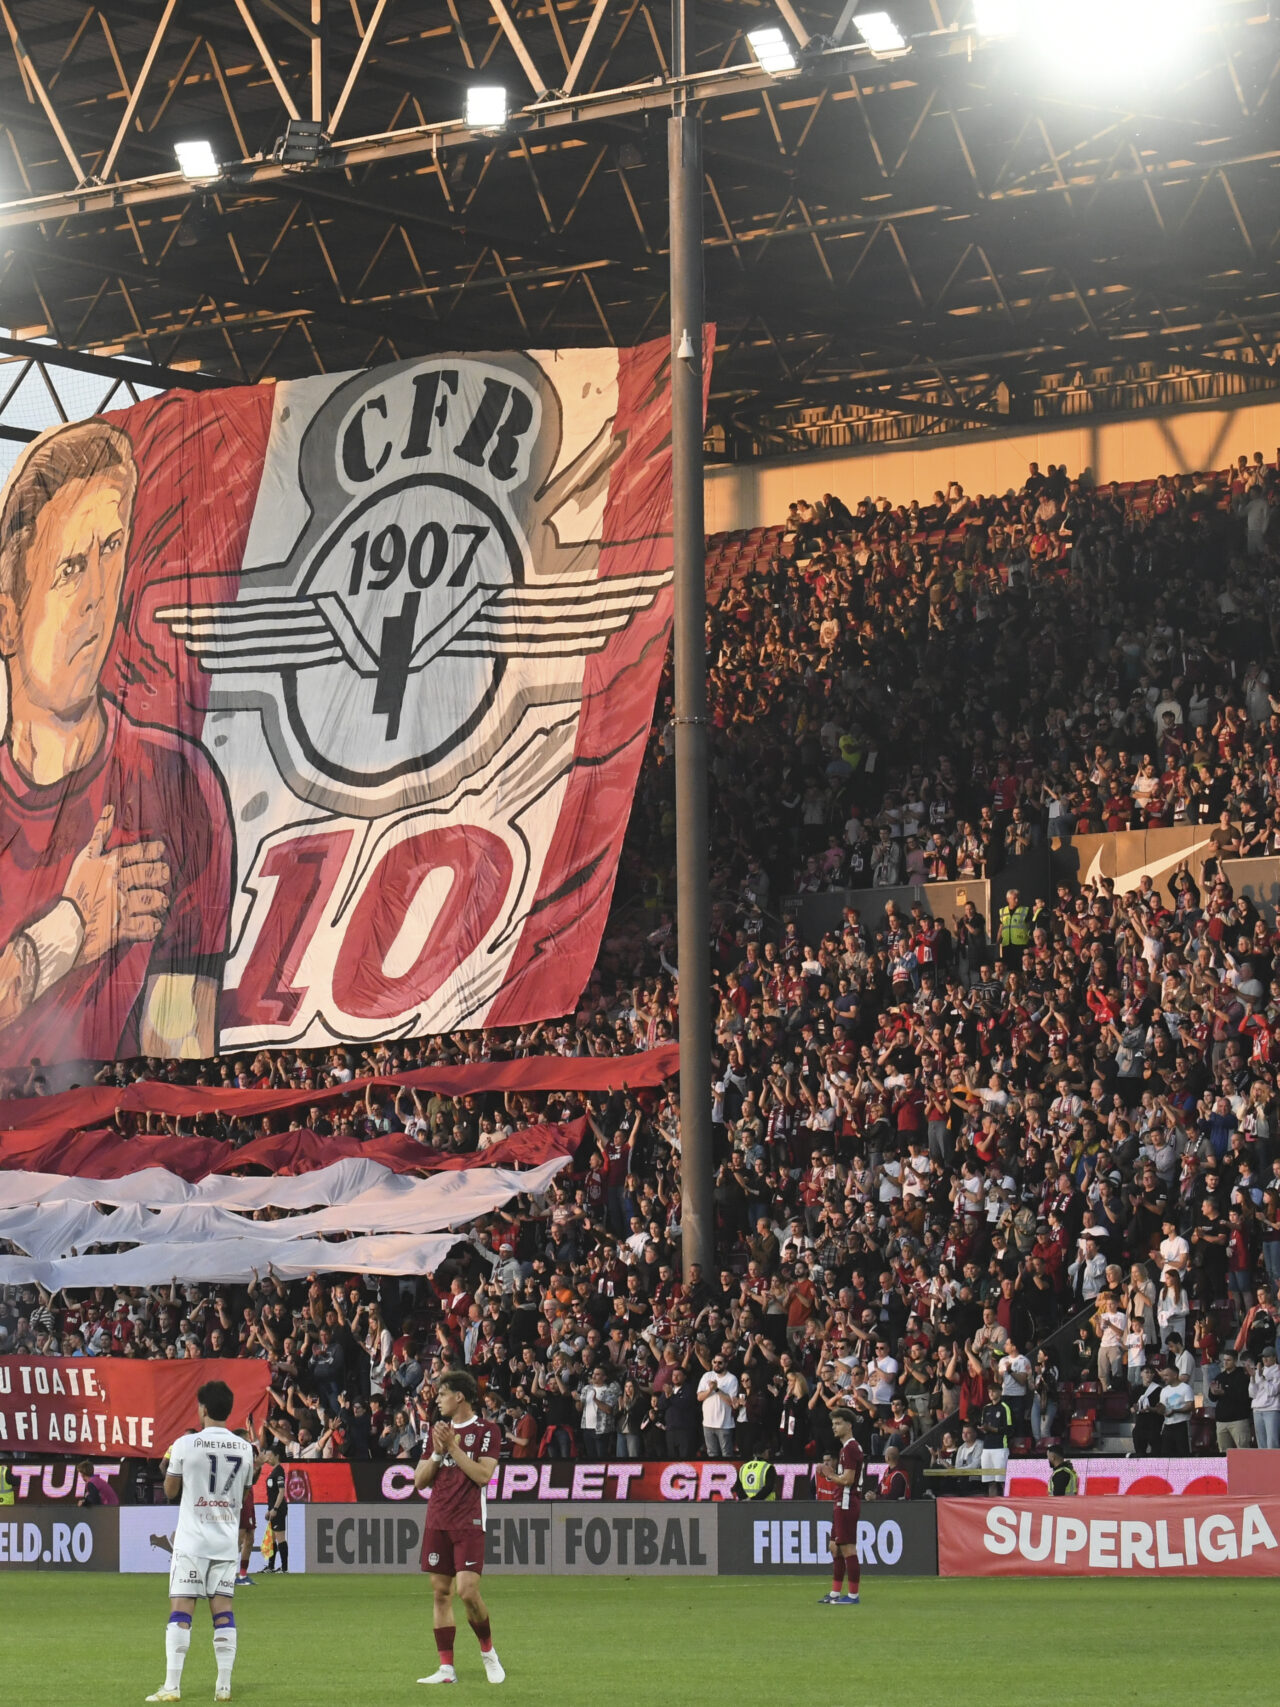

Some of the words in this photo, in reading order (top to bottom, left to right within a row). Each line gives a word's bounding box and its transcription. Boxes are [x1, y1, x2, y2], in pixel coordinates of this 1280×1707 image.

[341, 369, 534, 483] CFR
[349, 521, 490, 596] 1907
[220, 824, 514, 1029] 10
[206, 1453, 244, 1496] 17
[381, 1464, 642, 1501] CPLET
[317, 1517, 551, 1566] ECHIPENT
[565, 1516, 707, 1566] FOTBAL
[983, 1504, 1279, 1569] SUPERLIGA
